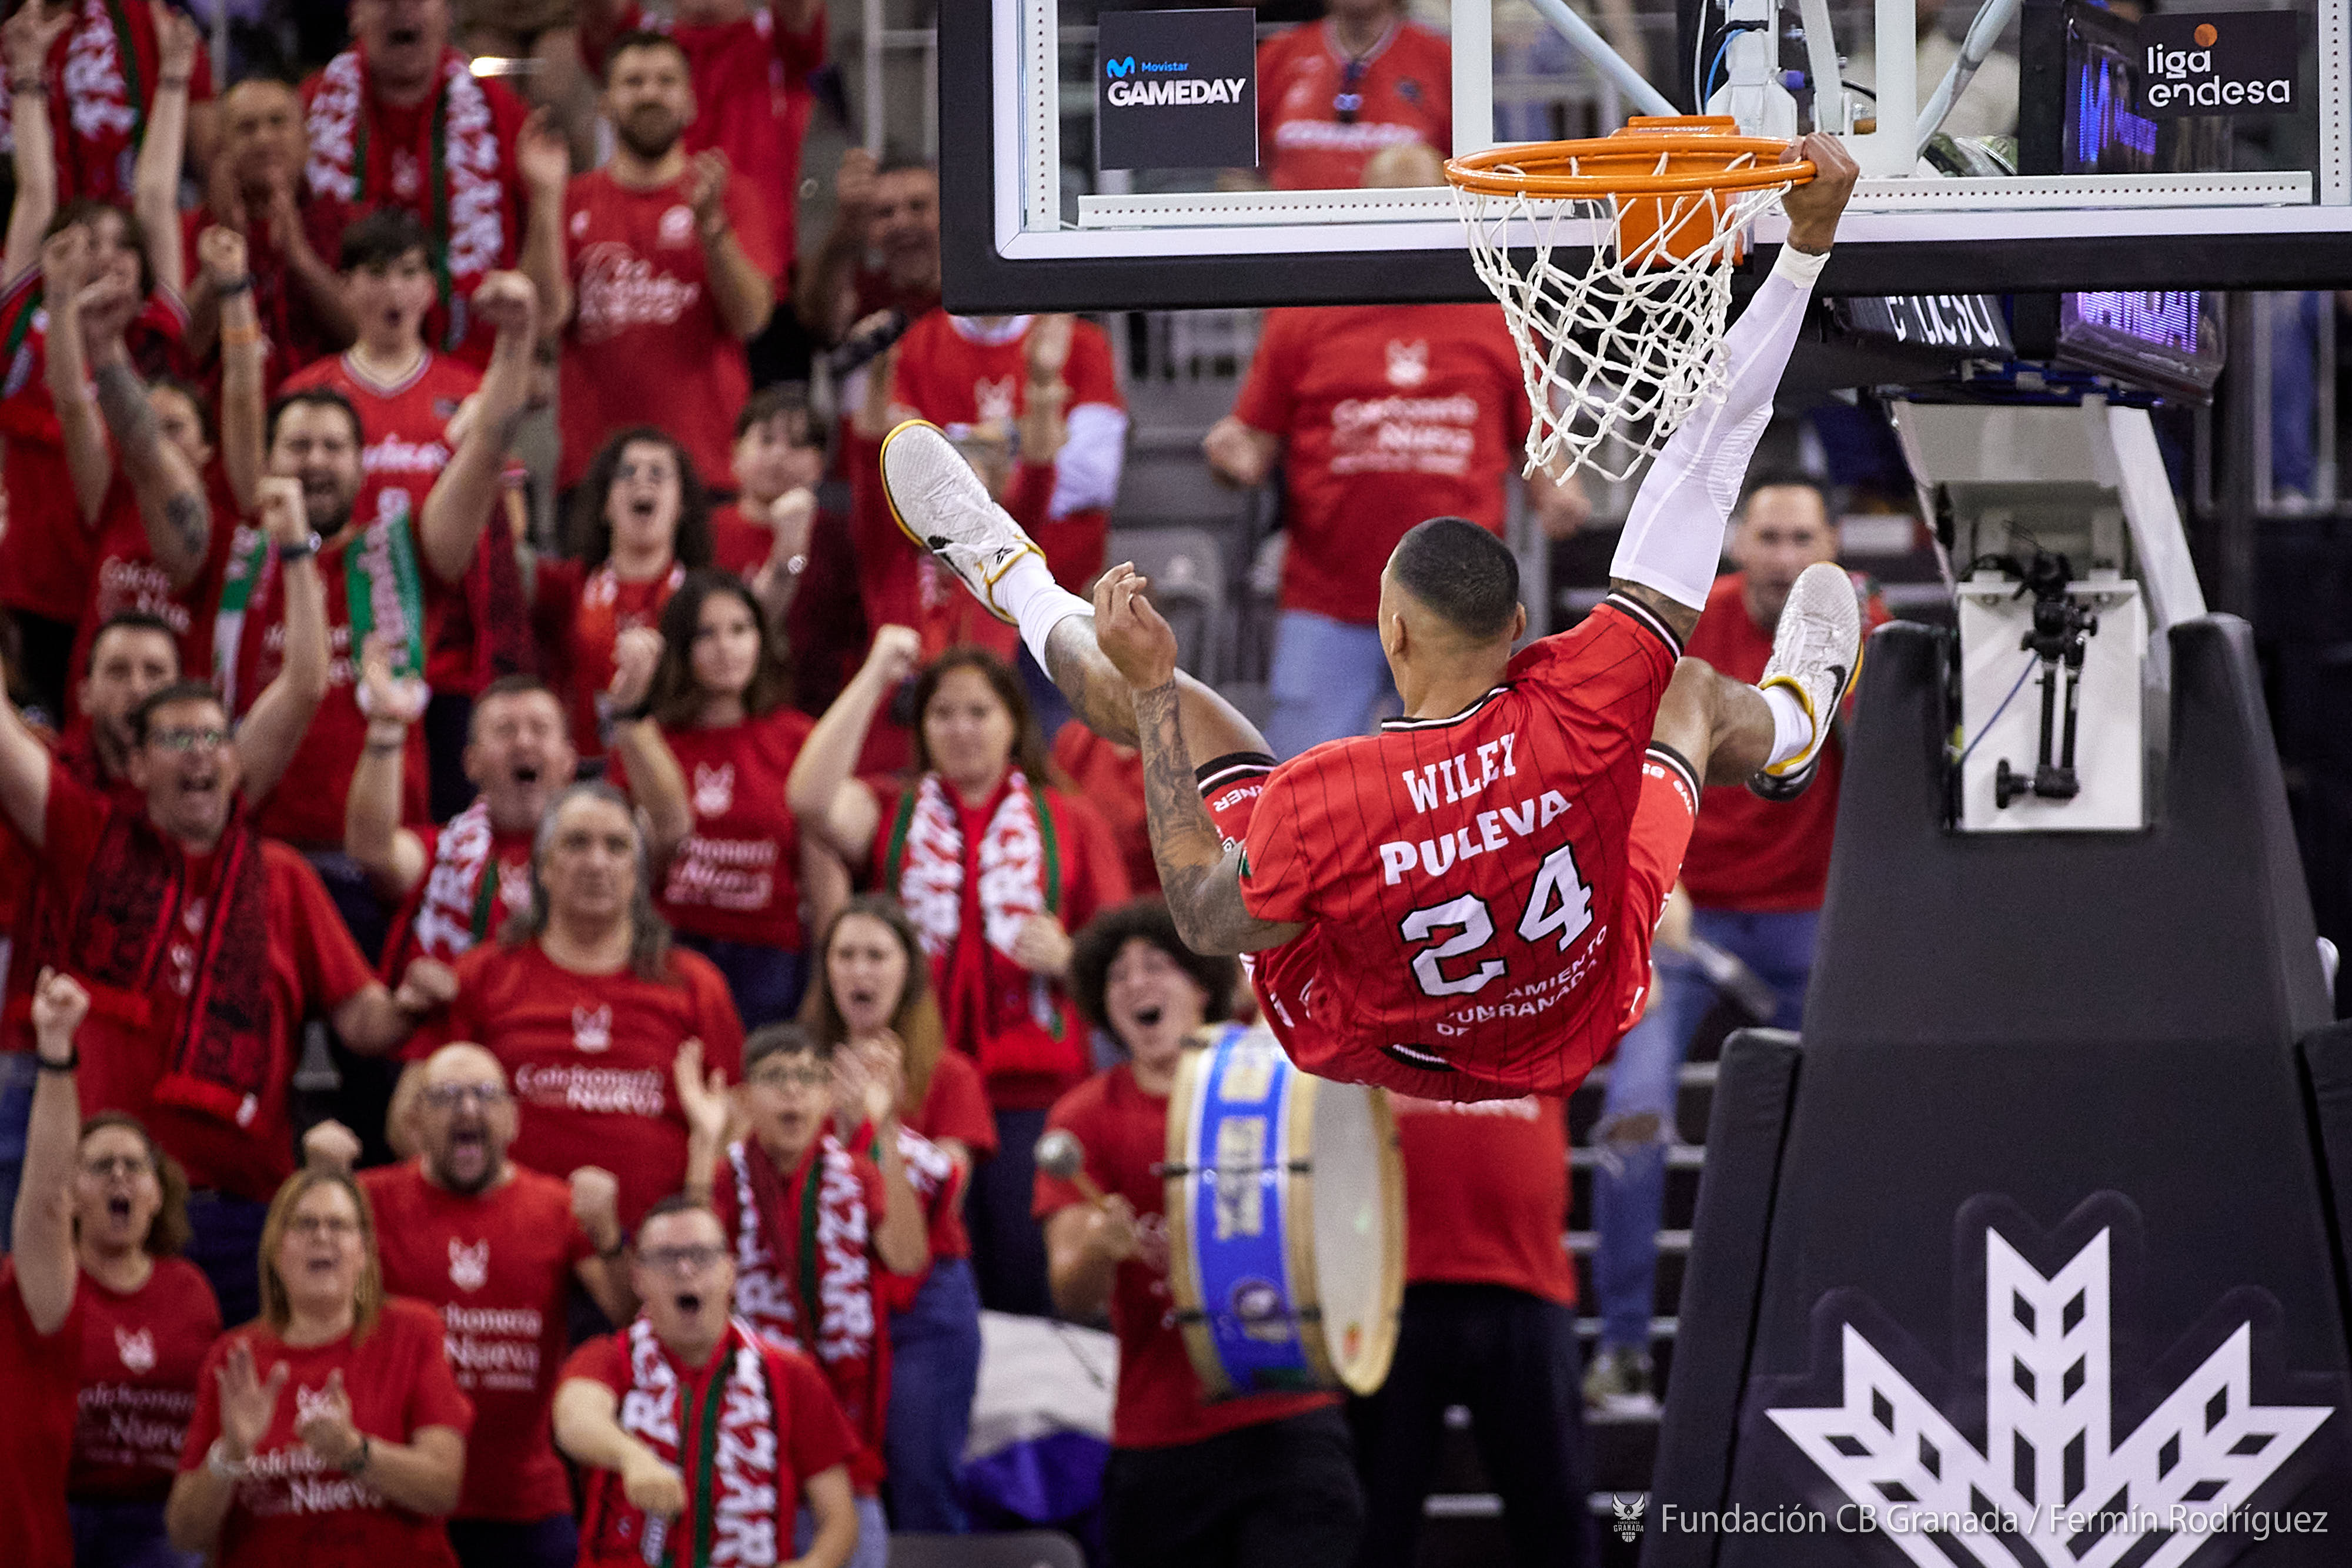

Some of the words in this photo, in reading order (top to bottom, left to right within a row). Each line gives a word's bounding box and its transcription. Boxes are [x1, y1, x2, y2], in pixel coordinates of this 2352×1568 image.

[1141, 61, 1188, 72] Movistar
[2147, 43, 2211, 79] liga
[1108, 78, 1246, 106] GAMEDAY
[2148, 75, 2290, 108] endesa
[1402, 733, 1516, 814] WILEY
[1379, 790, 1573, 886] PULEVA
[1397, 840, 1594, 997] 24
